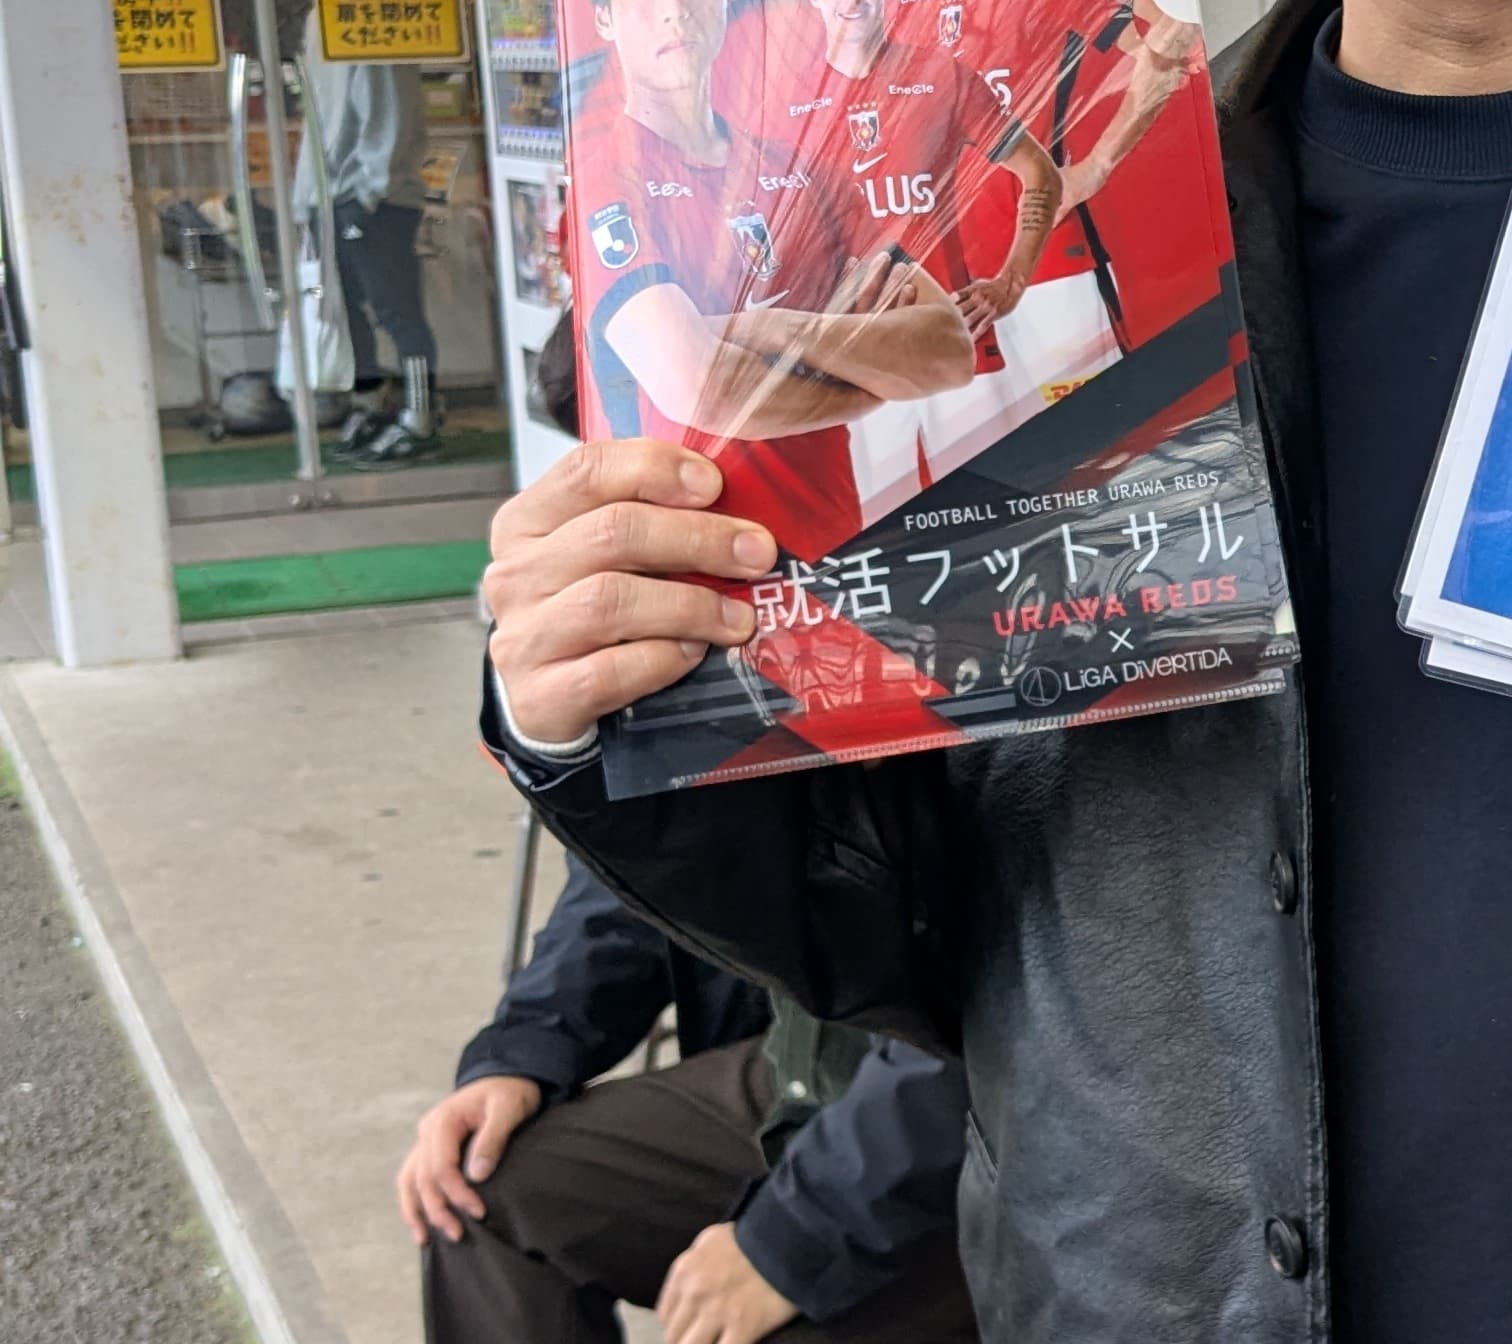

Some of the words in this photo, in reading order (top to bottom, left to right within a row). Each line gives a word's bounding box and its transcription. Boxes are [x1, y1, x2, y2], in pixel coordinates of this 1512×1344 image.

[856, 173, 936, 219] LUS
[904, 504, 998, 531] FOOTBALL
[1006, 488, 1100, 515] TOGETHER
[1108, 481, 1166, 502] URAWA
[1175, 470, 1220, 489] REDS
[752, 502, 1244, 633] 就活フットサル
[991, 591, 1128, 637] URAWA
[1140, 574, 1240, 614] REDS
